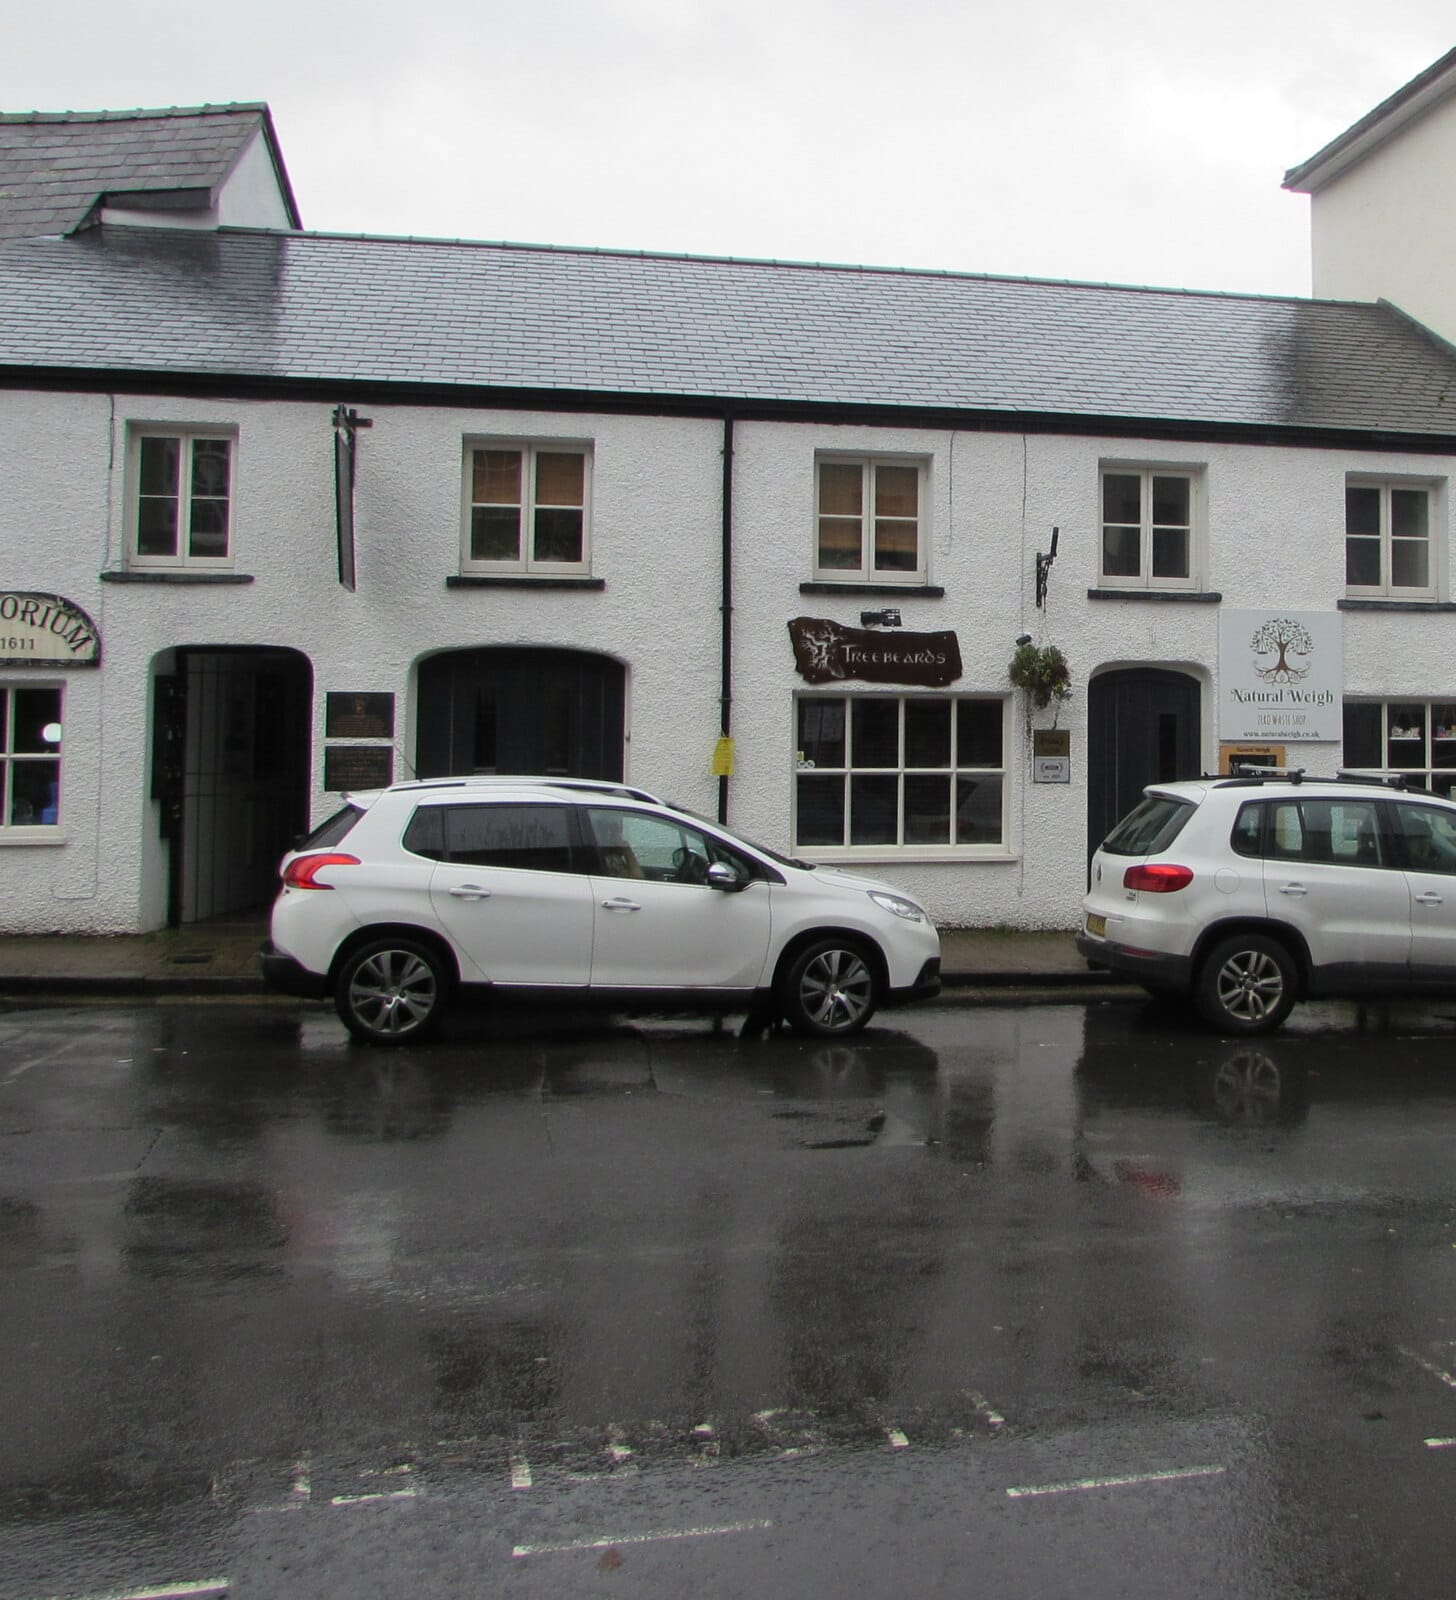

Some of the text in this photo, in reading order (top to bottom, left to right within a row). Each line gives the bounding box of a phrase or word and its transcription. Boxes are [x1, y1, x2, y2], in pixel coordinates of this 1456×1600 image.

[0, 596, 93, 653] ORIUM
[0, 636, 35, 650] 1611
[1231, 688, 1333, 706] Natural Weigh
